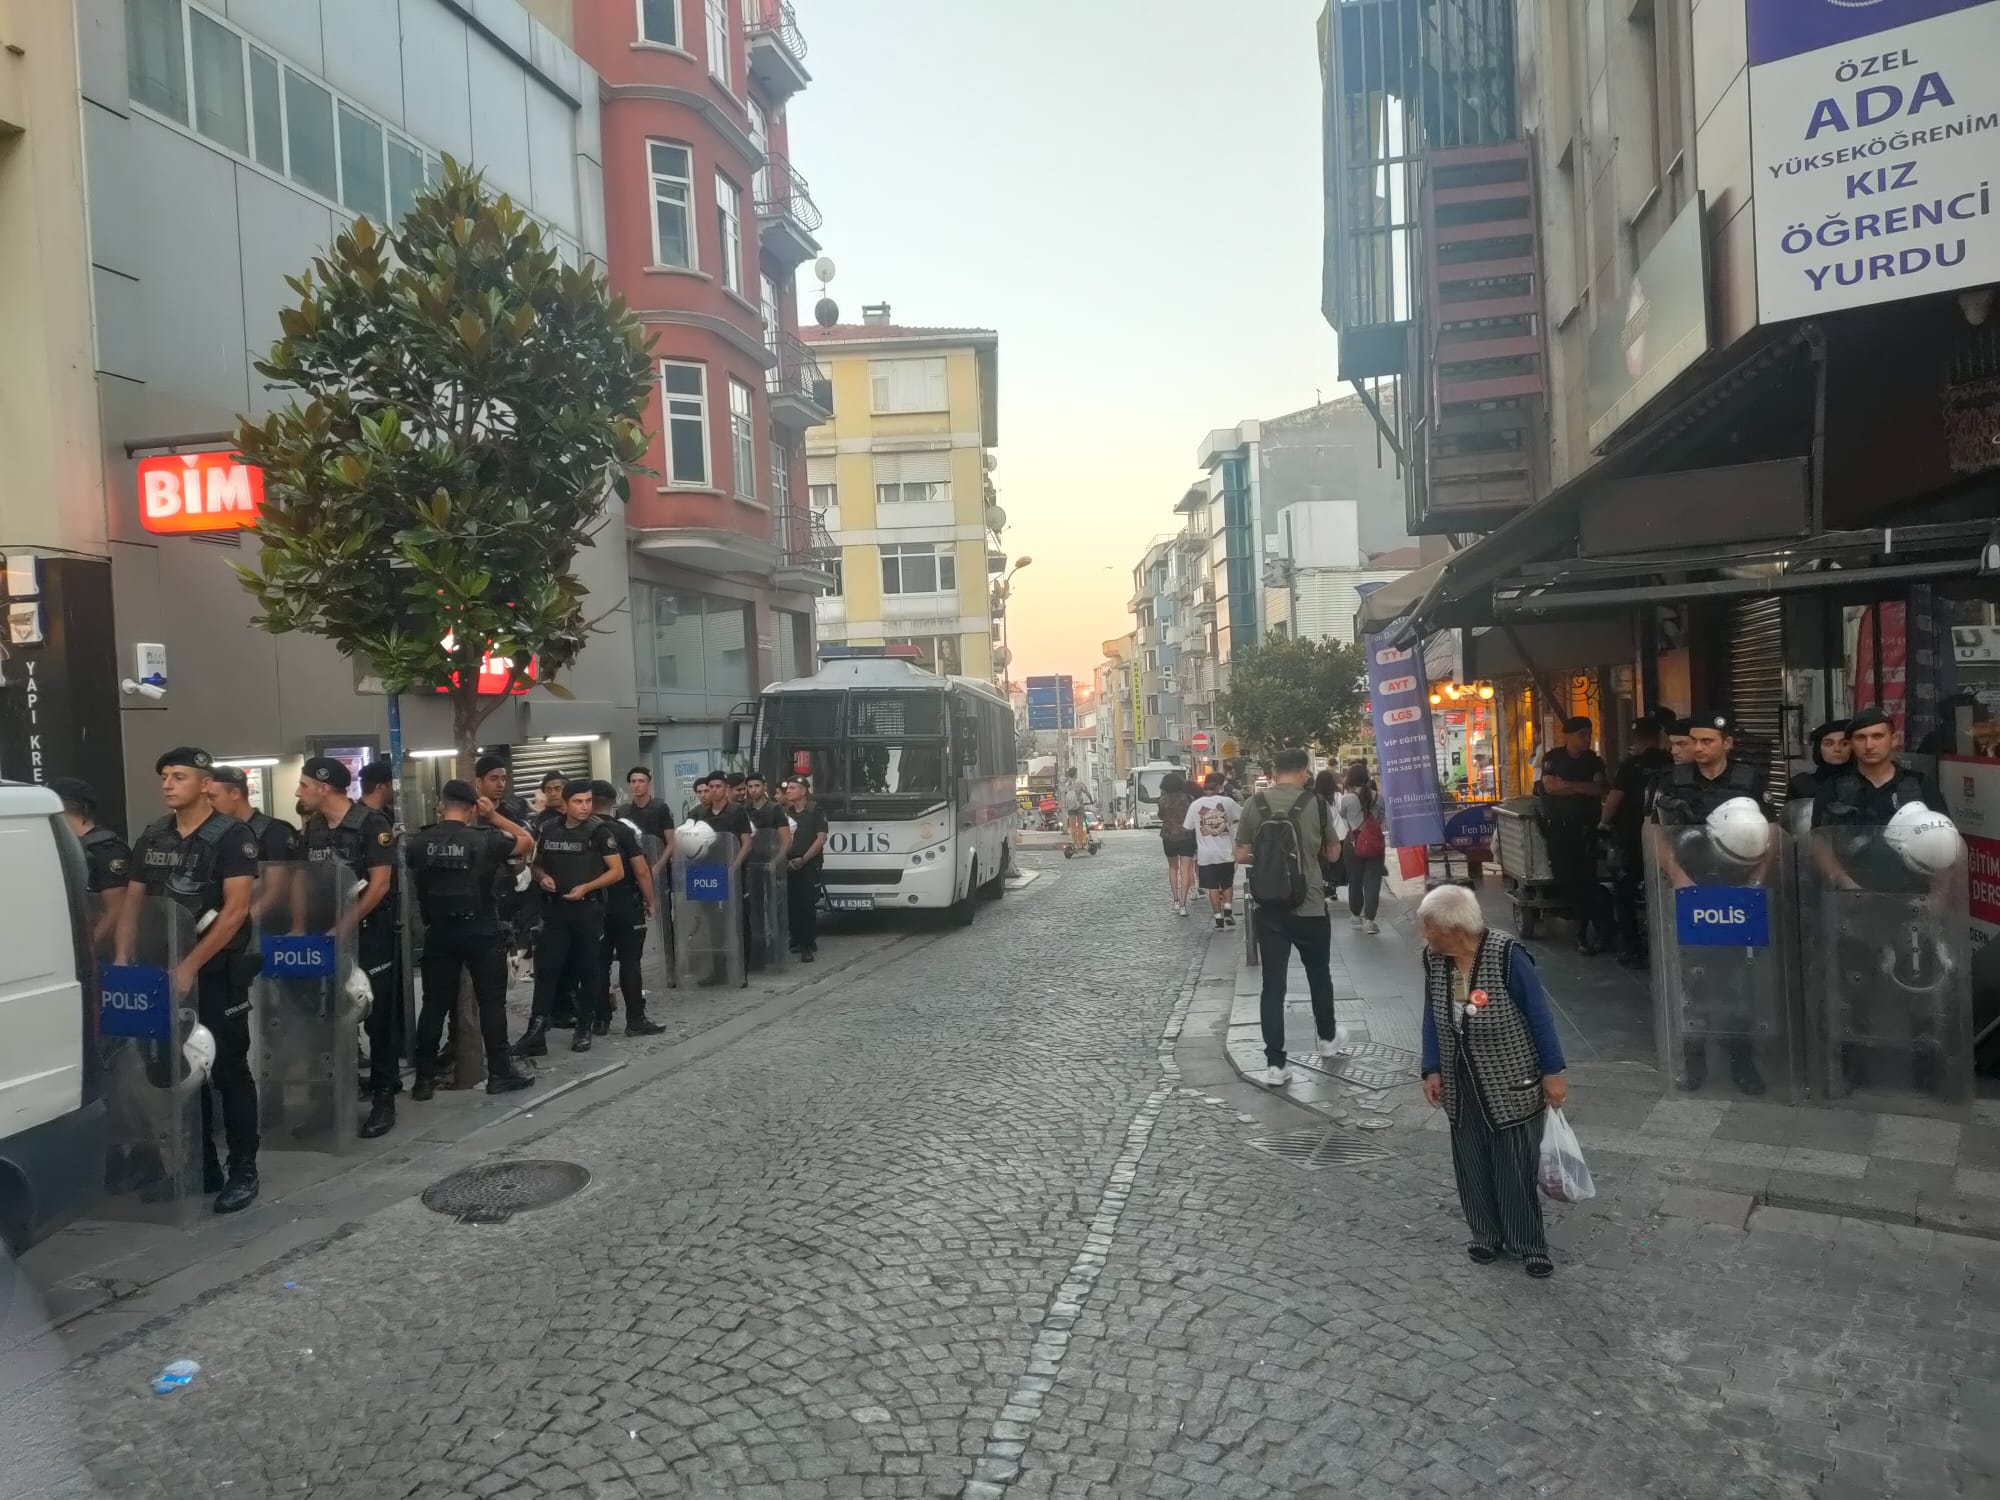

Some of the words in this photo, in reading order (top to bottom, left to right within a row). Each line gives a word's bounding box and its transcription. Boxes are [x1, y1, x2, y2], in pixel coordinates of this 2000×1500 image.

[1835, 48, 1919, 83] ÖZEL
[1804, 71, 1955, 140] ADA
[1768, 113, 2000, 179] YÜKSEKÖĞRENİM
[1846, 161, 1918, 200] KIZ
[1781, 181, 1990, 254] ÖĞRENCİ
[1804, 239, 1966, 291] YURDU
[144, 454, 253, 519] BİM
[26, 661, 39, 724] YAPI
[1388, 679, 1409, 692] AYT
[1391, 710, 1413, 722] LGS
[30, 735, 43, 783] KRE
[829, 826, 890, 853] OLİS
[1461, 825, 1478, 835] Fen
[1968, 848, 2000, 879] ĞİTİM
[1693, 905, 1746, 924] POLİS
[273, 947, 322, 966] POLİS
